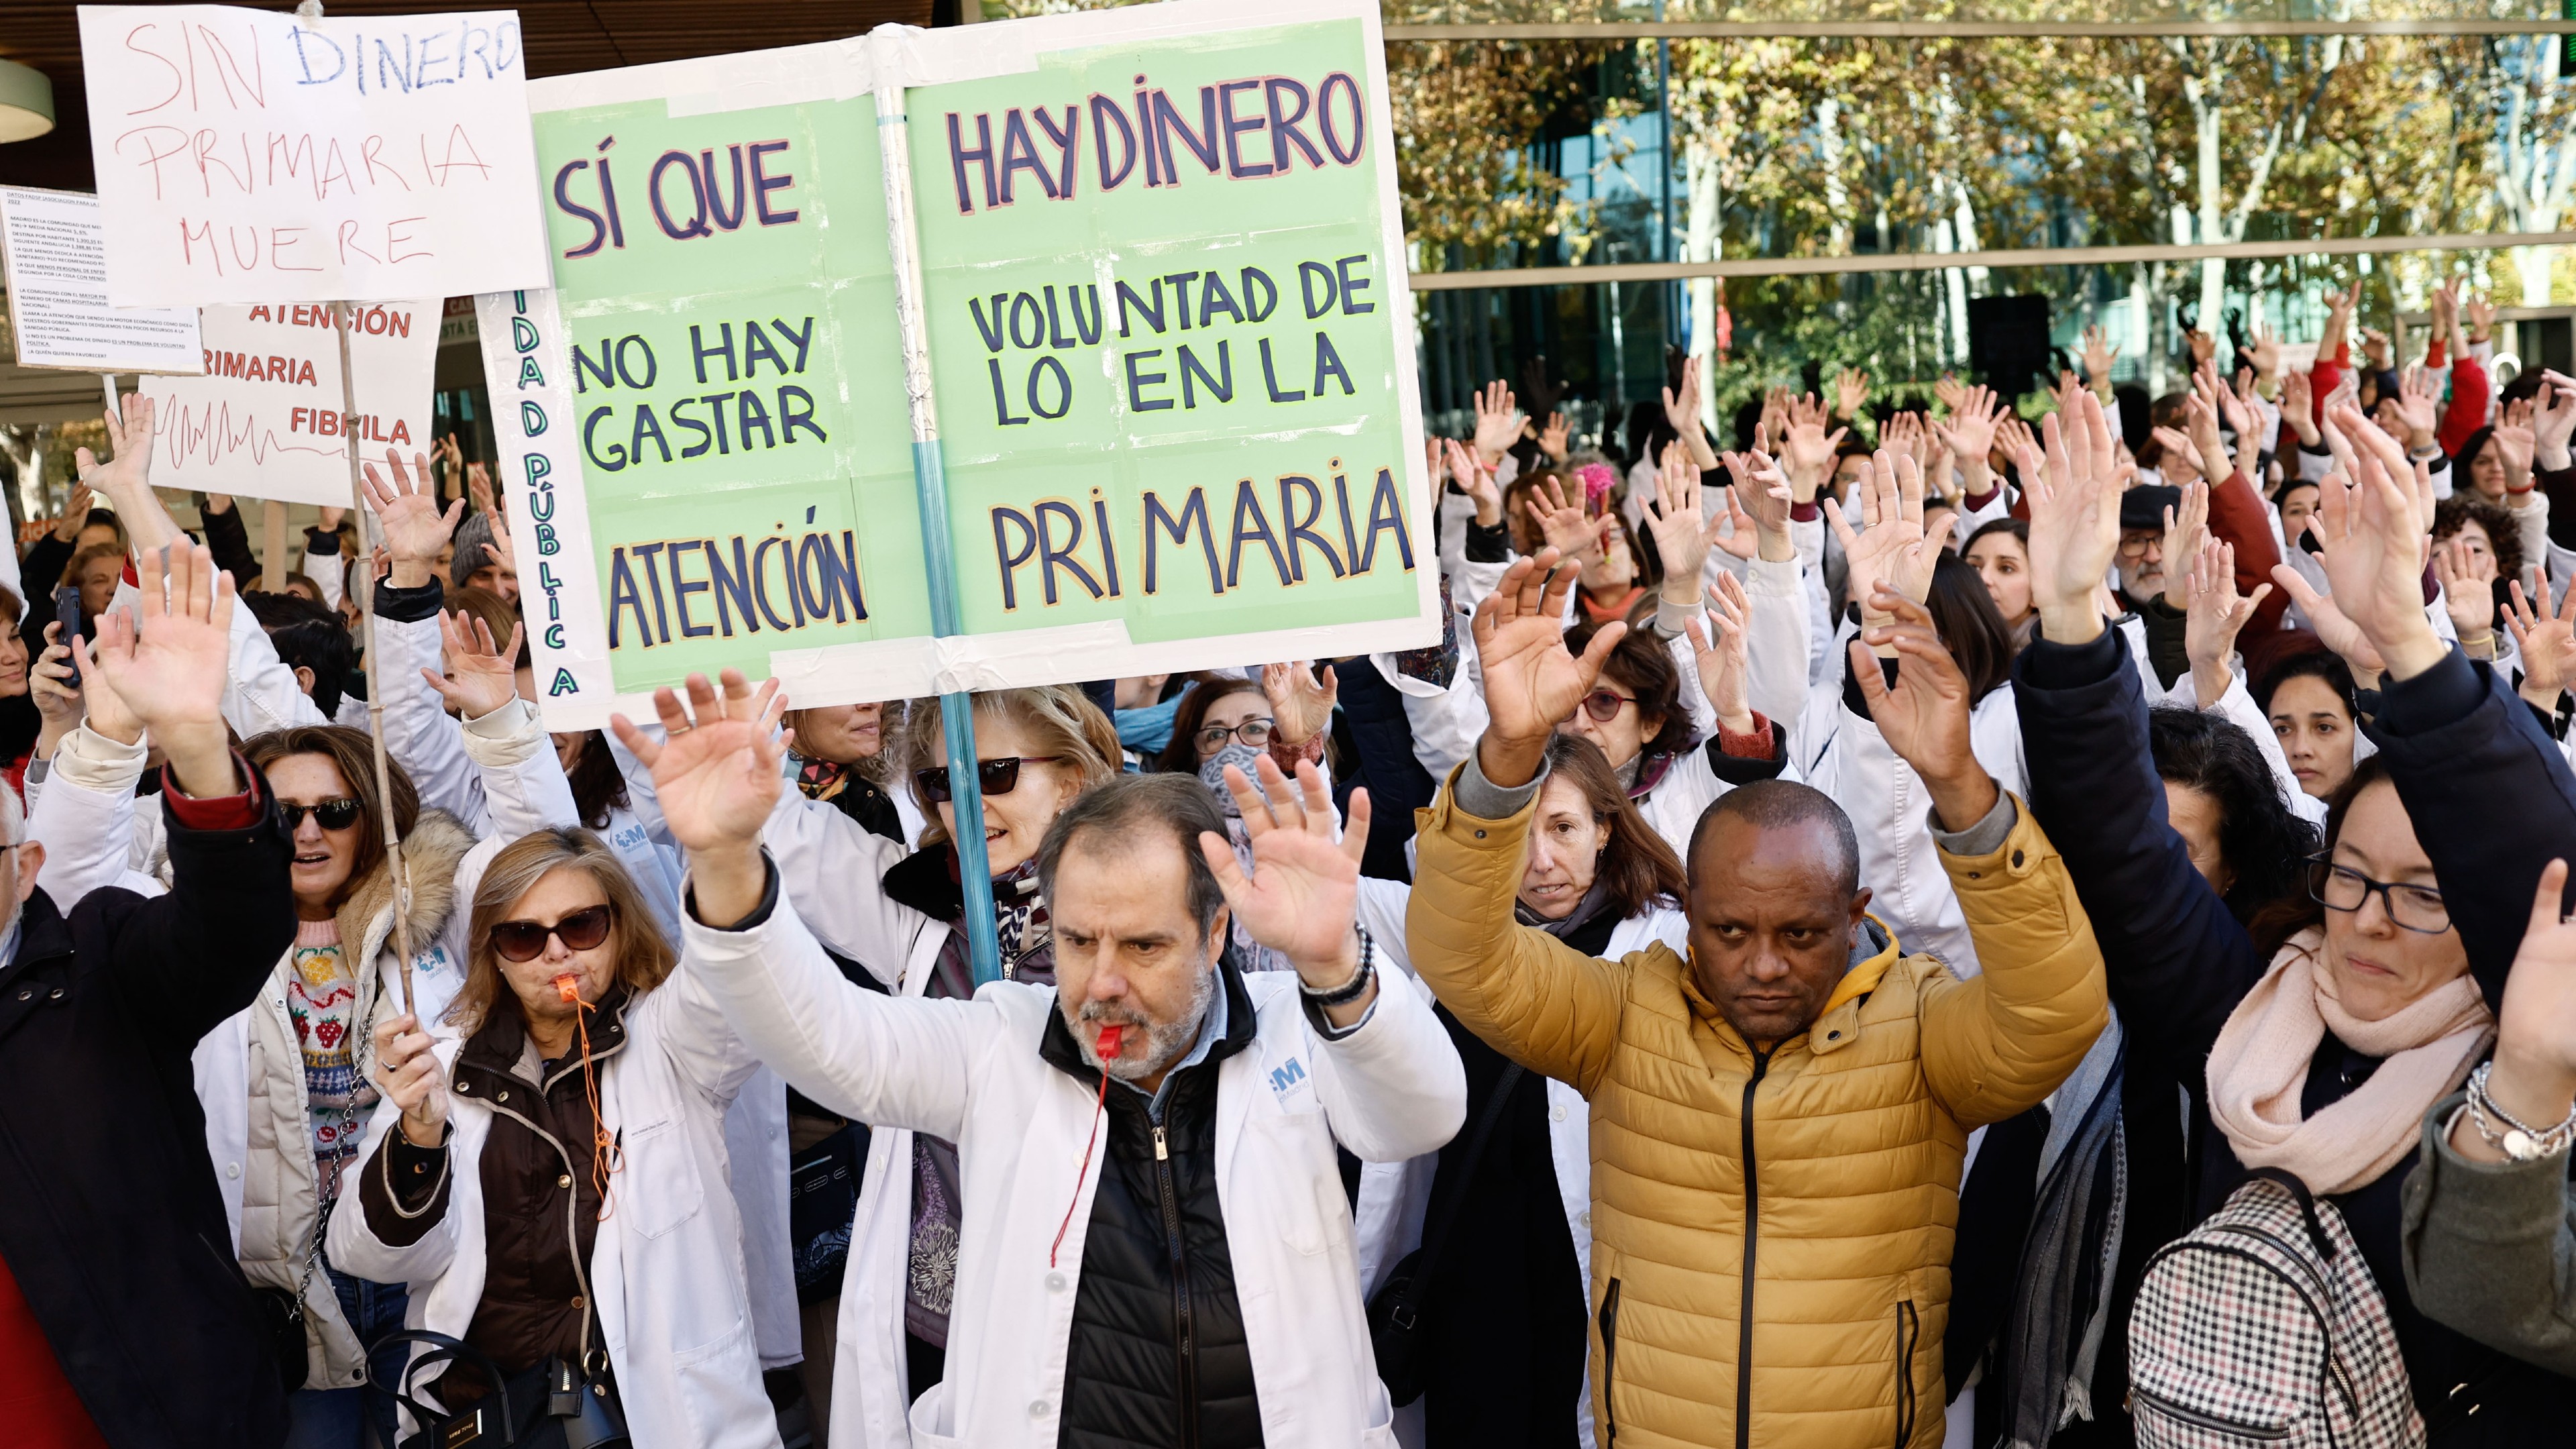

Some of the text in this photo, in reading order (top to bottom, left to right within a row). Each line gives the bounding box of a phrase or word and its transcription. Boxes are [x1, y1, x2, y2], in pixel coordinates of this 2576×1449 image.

[126, 19, 519, 115] SIN DINERO
[115, 124, 493, 201] PRIMARIA
[553, 135, 625, 260] SÍ
[648, 138, 800, 241] QUE
[180, 216, 434, 276] MUERE
[203, 349, 317, 386] RIMARIA
[570, 254, 1375, 394] NO HAY VOLUNTAD DE
[583, 331, 1356, 472] GASTAR LO EN LA
[608, 455, 1417, 651] ATENCIÓN PRIMARIA
